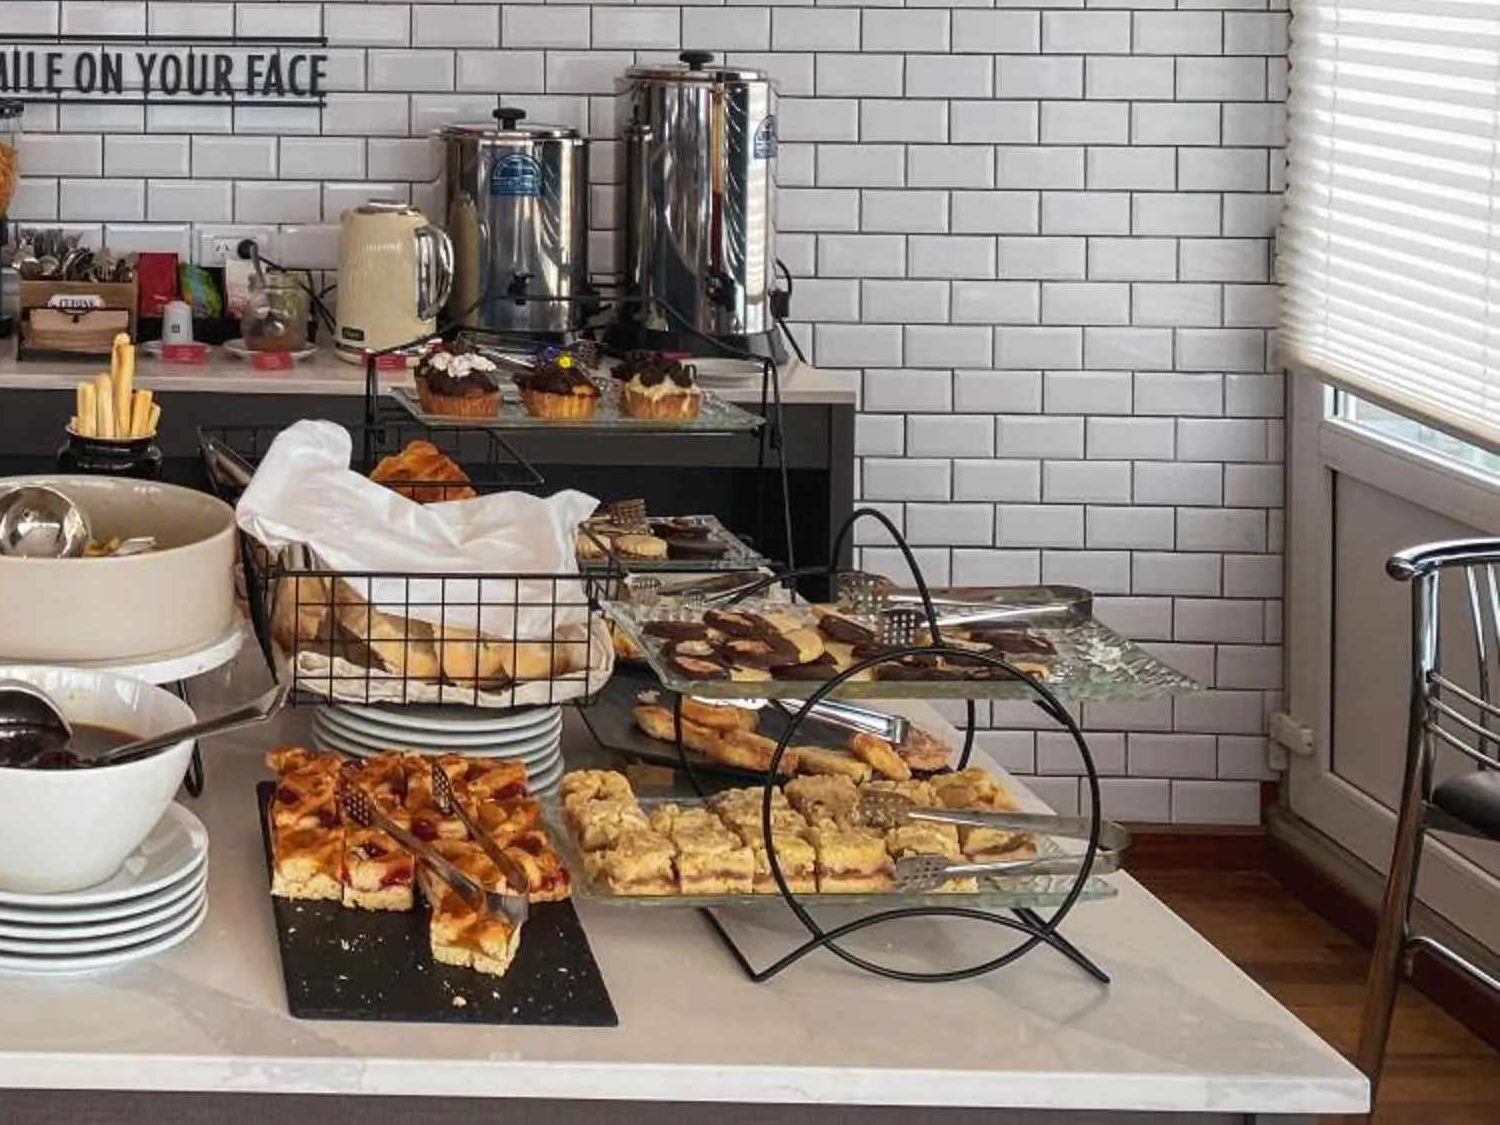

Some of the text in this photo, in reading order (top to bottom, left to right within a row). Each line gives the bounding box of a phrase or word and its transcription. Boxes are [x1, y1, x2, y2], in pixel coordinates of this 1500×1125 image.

[74, 52, 123, 94] ON
[136, 53, 234, 96] YOUR
[247, 55, 328, 97] FACE
